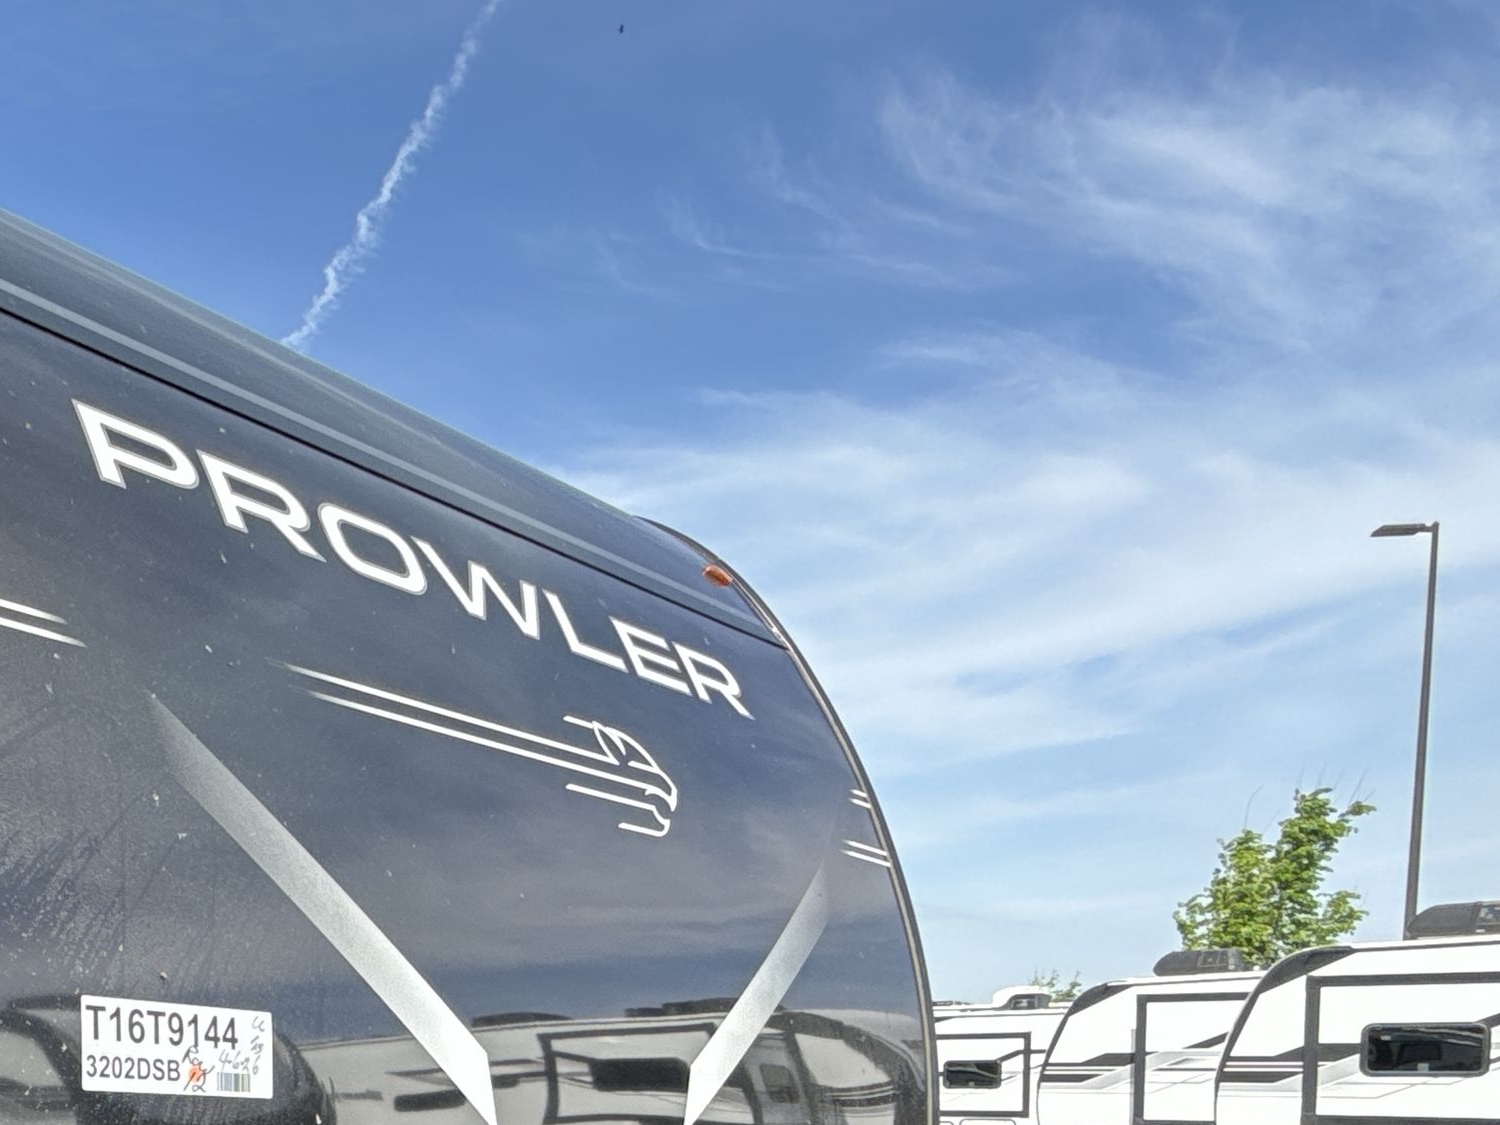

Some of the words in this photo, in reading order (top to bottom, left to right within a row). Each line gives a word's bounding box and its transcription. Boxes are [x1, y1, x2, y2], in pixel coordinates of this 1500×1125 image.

[70, 398, 756, 721] PROWLER
[85, 1005, 238, 1050] T16T9144
[86, 1054, 181, 1082] 3202DSB
